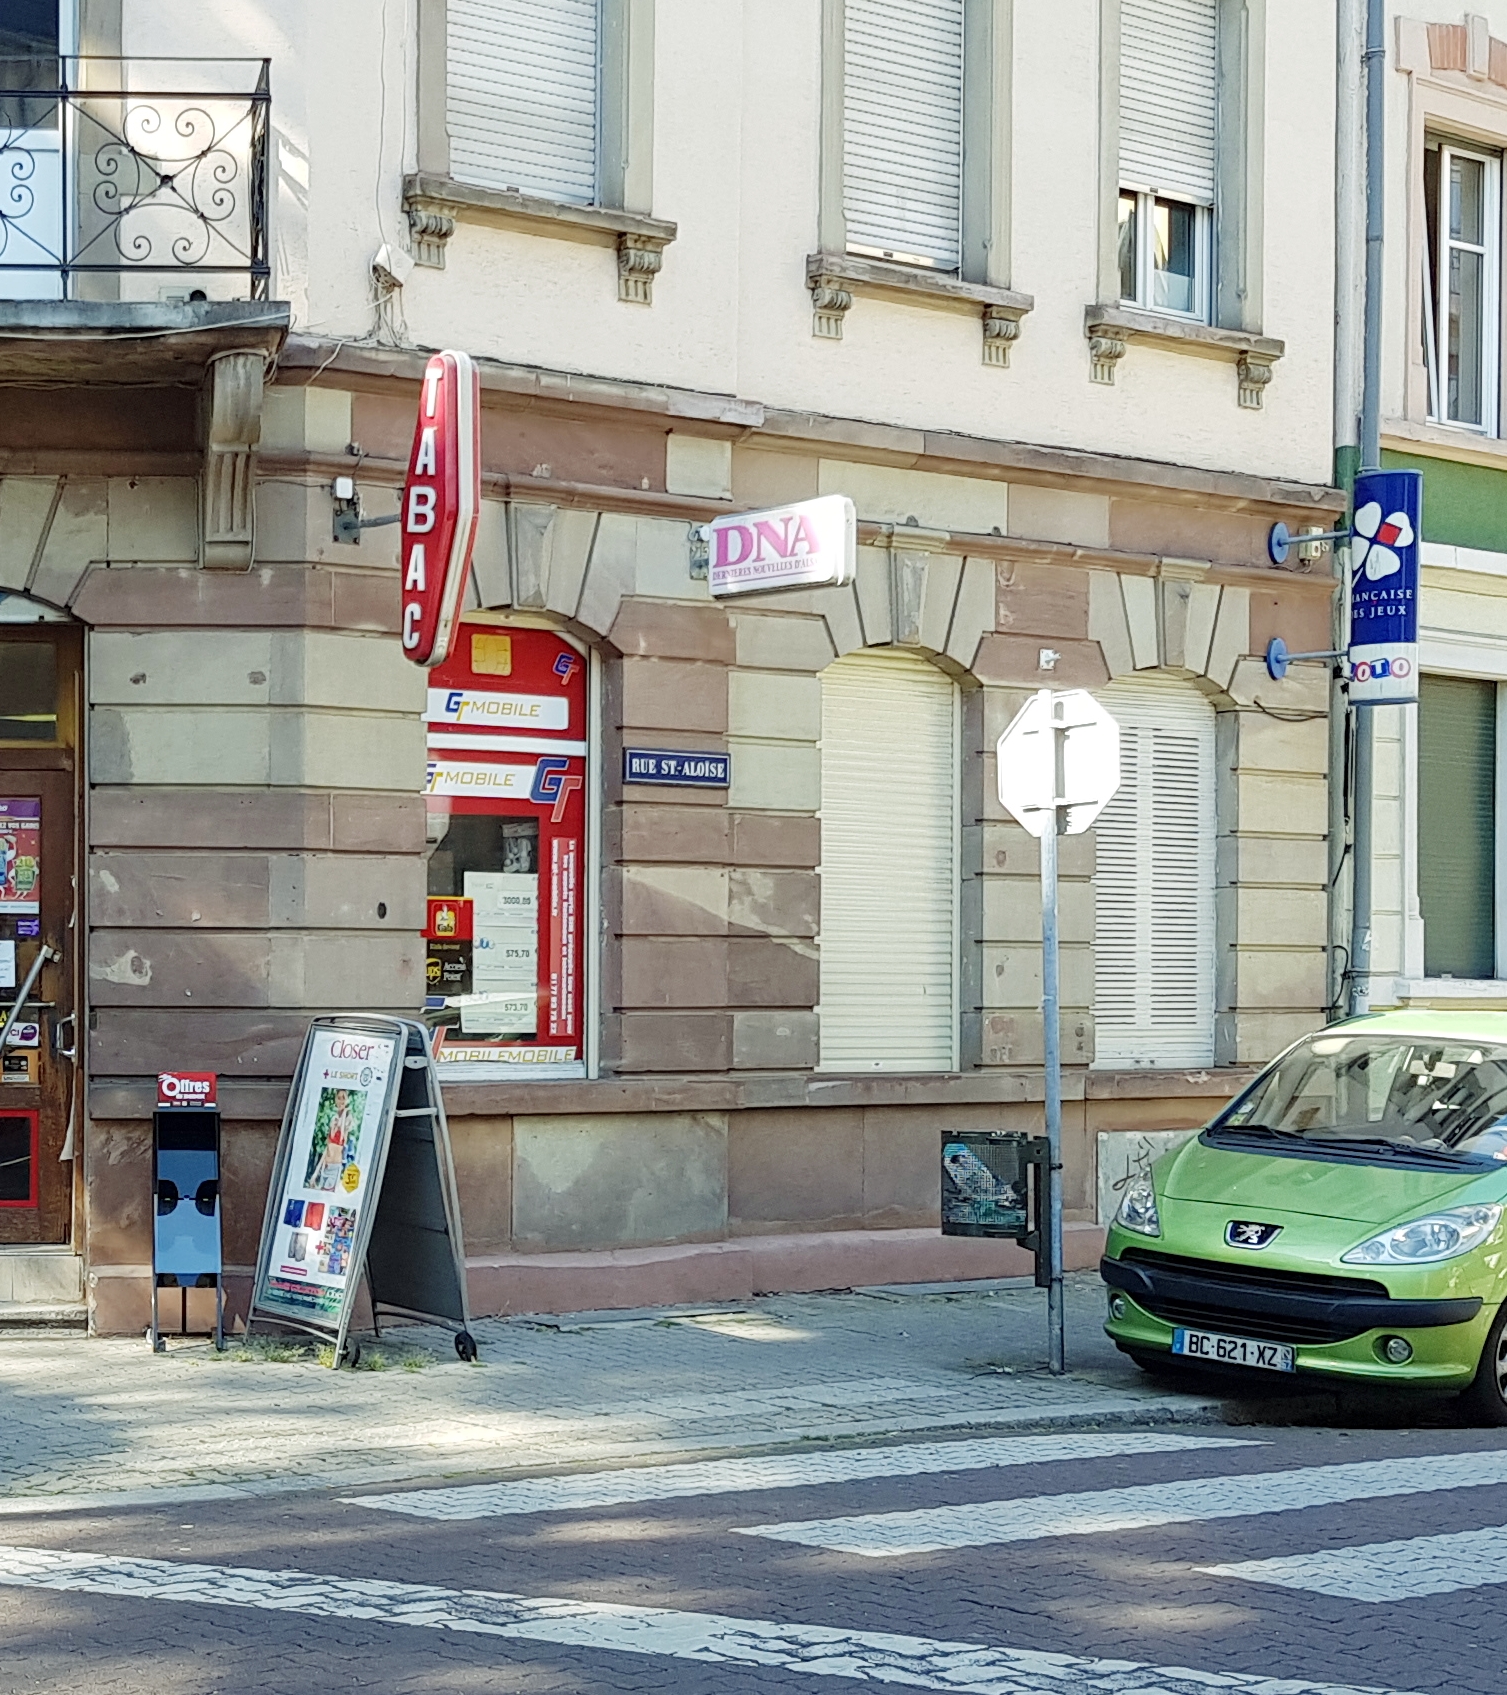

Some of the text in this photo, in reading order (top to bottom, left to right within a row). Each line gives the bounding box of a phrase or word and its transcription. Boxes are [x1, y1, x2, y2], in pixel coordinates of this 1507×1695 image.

[403, 367, 443, 649] TABAC
[712, 514, 821, 569] DNA
[1369, 605, 1407, 619] JEUX
[1351, 657, 1412, 683] OTO
[470, 701, 541, 717] MOBILE
[632, 758, 657, 774] RUE
[445, 771, 515, 787] MOBILE
[330, 1039, 375, 1060] Closer
[161, 1076, 210, 1097] Offres
